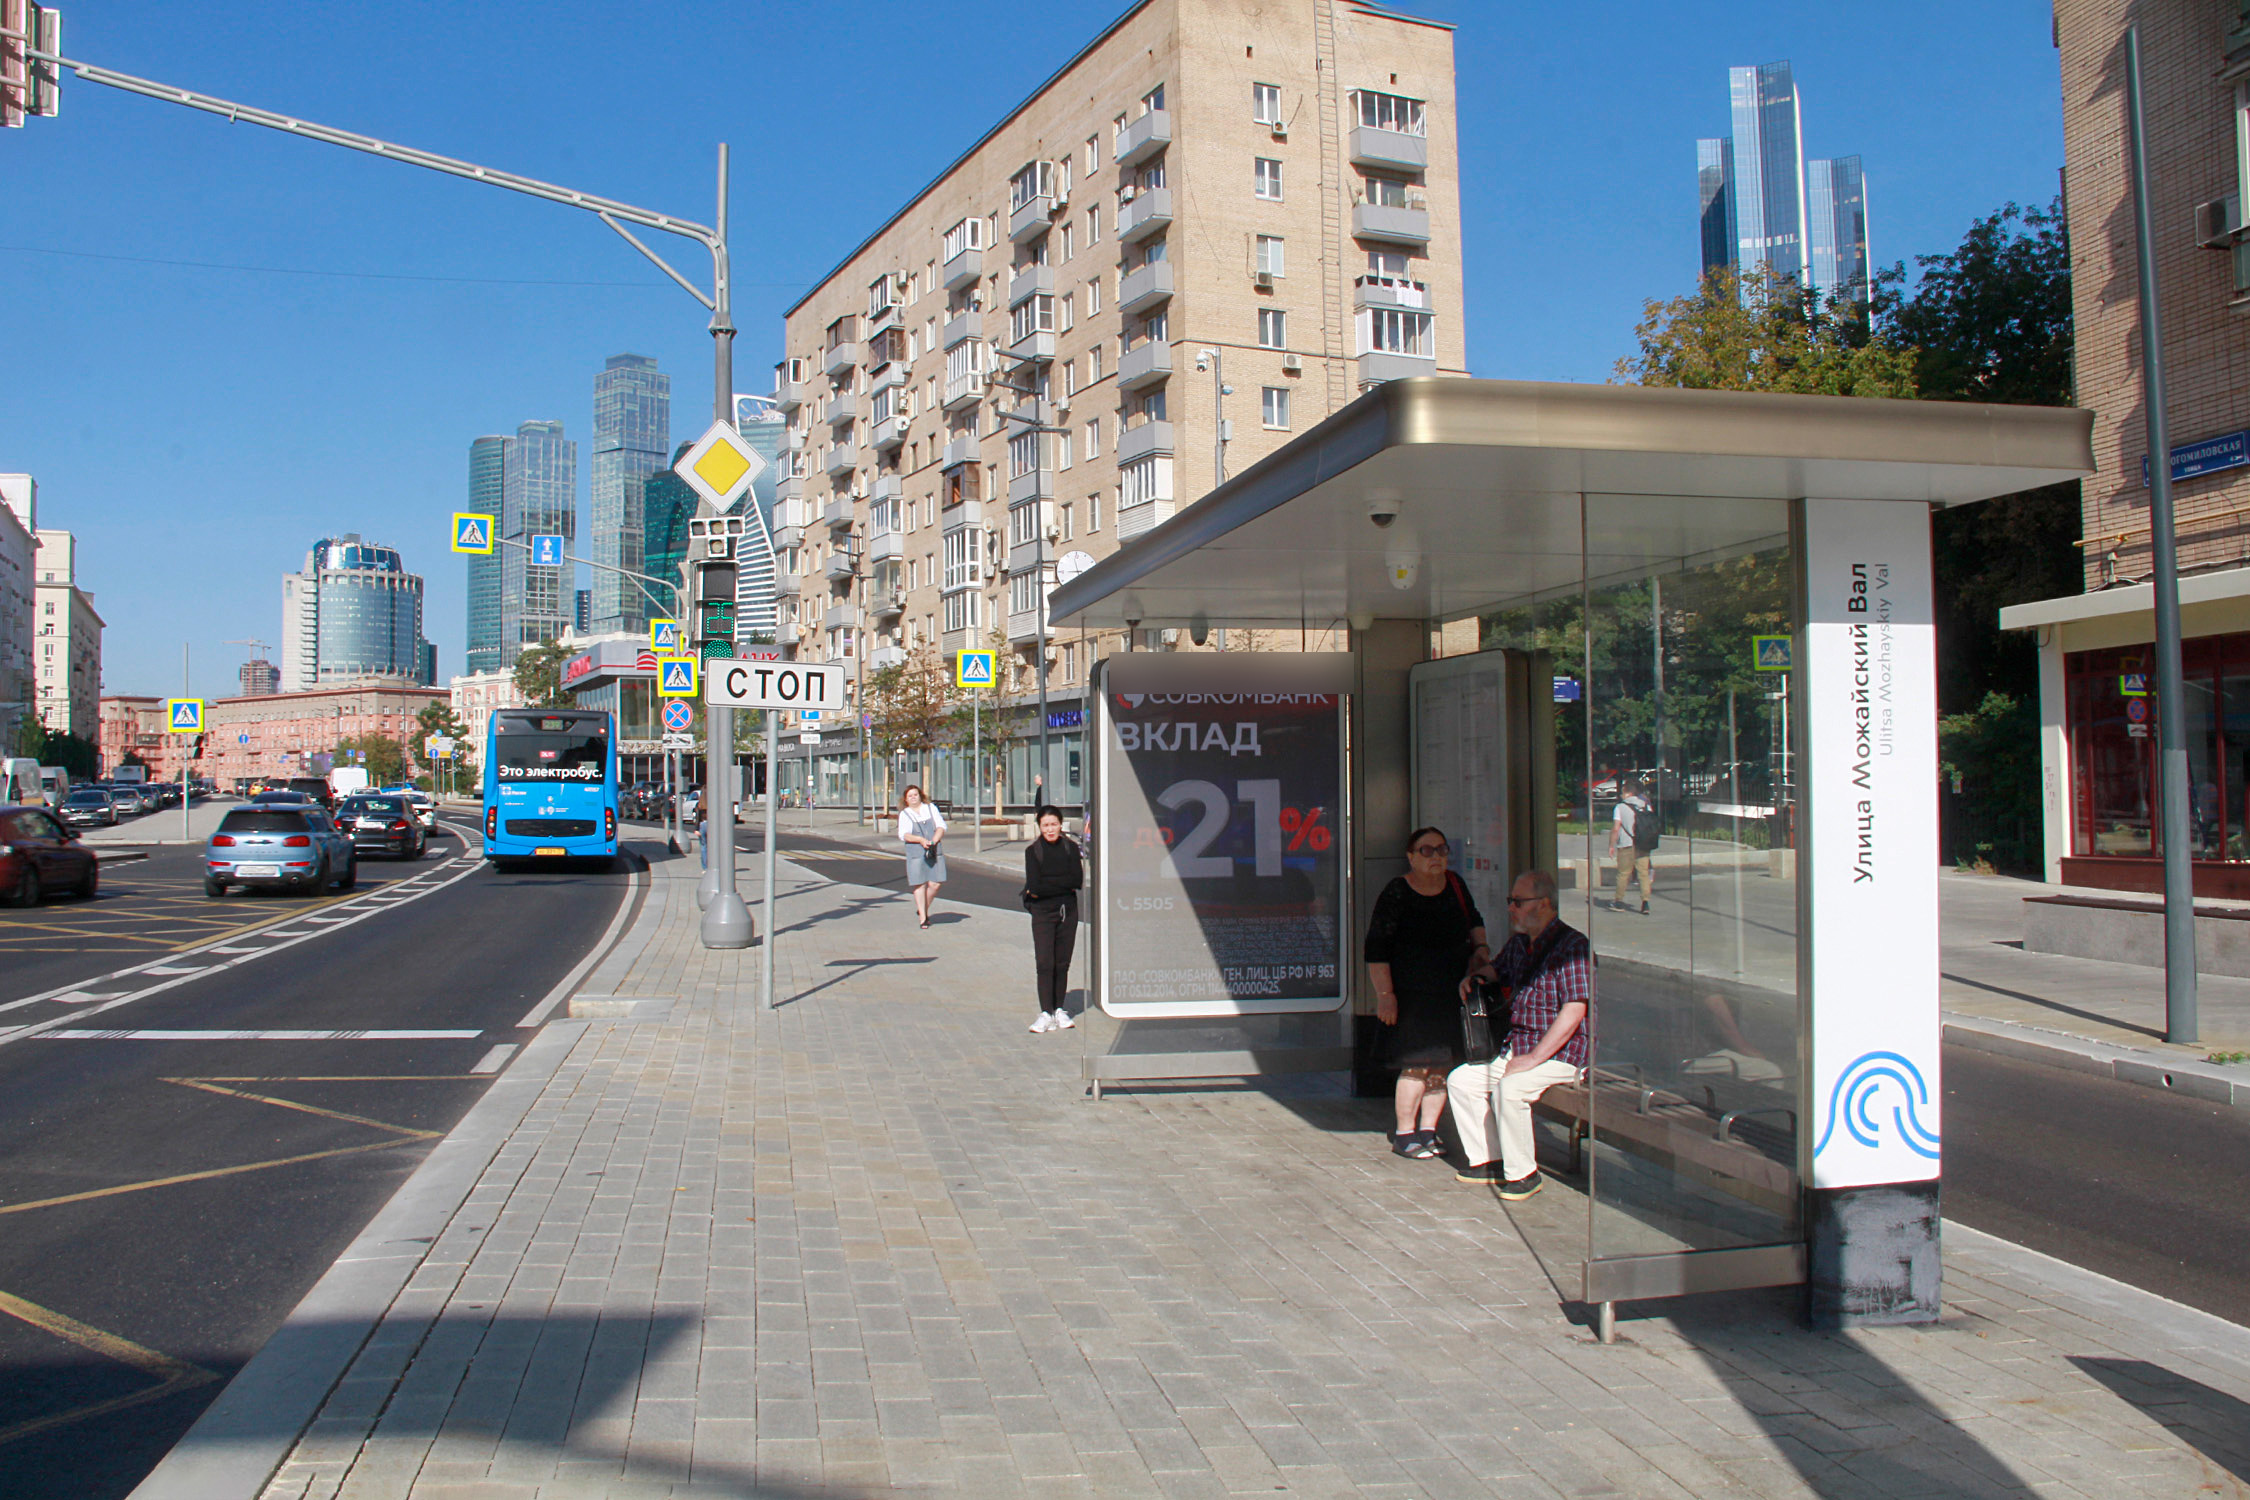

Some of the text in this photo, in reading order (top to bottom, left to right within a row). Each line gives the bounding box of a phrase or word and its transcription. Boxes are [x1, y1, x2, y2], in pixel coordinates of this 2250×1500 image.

[1874, 563, 1893, 756] Ulitsa Mozhayskiy Val
[726, 667, 824, 702] СТОП
[1848, 563, 1874, 884] Улица Можайский Вал
[1115, 722, 1261, 756] ВКЛАД
[500, 765, 603, 780] Это электробус.
[1133, 897, 1174, 911] 5505
[1113, 970, 1136, 984] ПАО
[1223, 967, 1244, 980] ГЕН.
[1272, 965, 1287, 980] ЦБ
[1288, 965, 1304, 979] РФ
[1318, 964, 1335, 978] 963
[1113, 985, 1128, 998] ОТ
[1179, 982, 1205, 996] ОГРН
